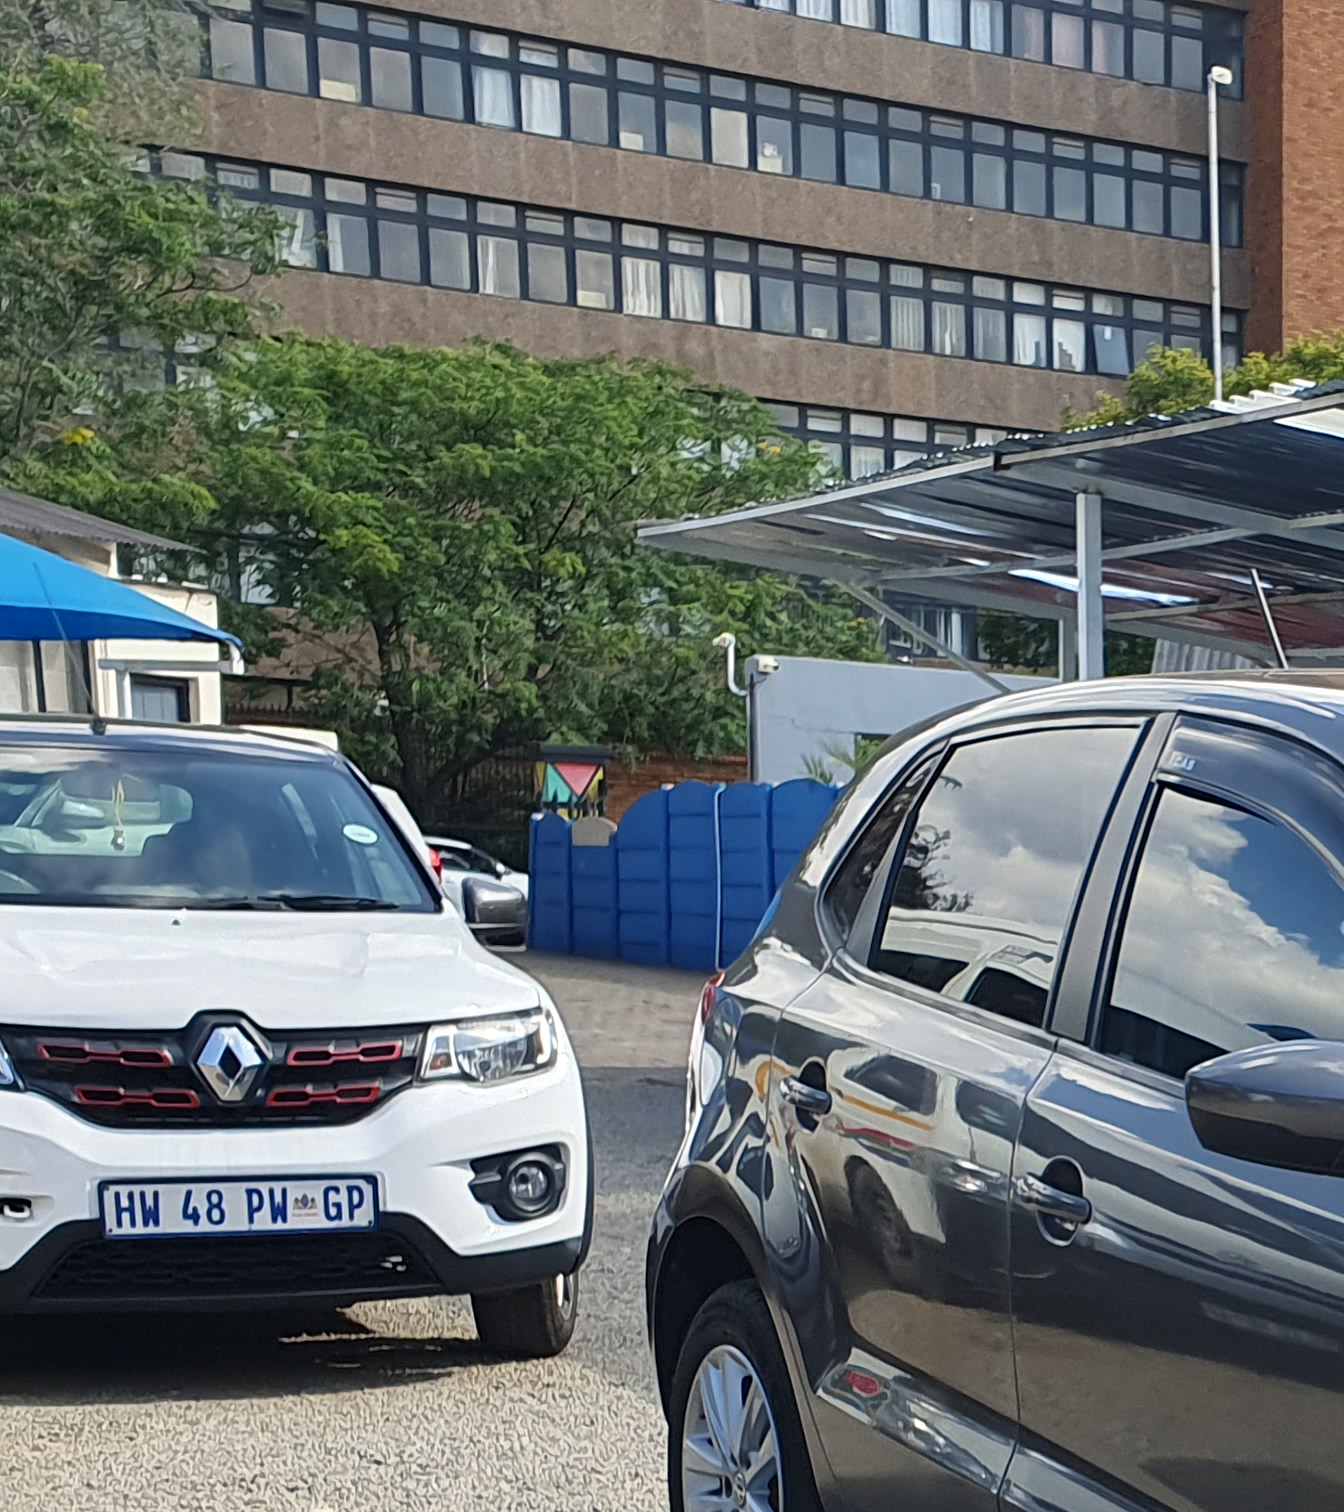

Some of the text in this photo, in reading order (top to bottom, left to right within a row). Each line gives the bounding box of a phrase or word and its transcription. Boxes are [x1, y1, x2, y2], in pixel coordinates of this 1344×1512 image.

[114, 1184, 365, 1229] HW 48 PW GP
